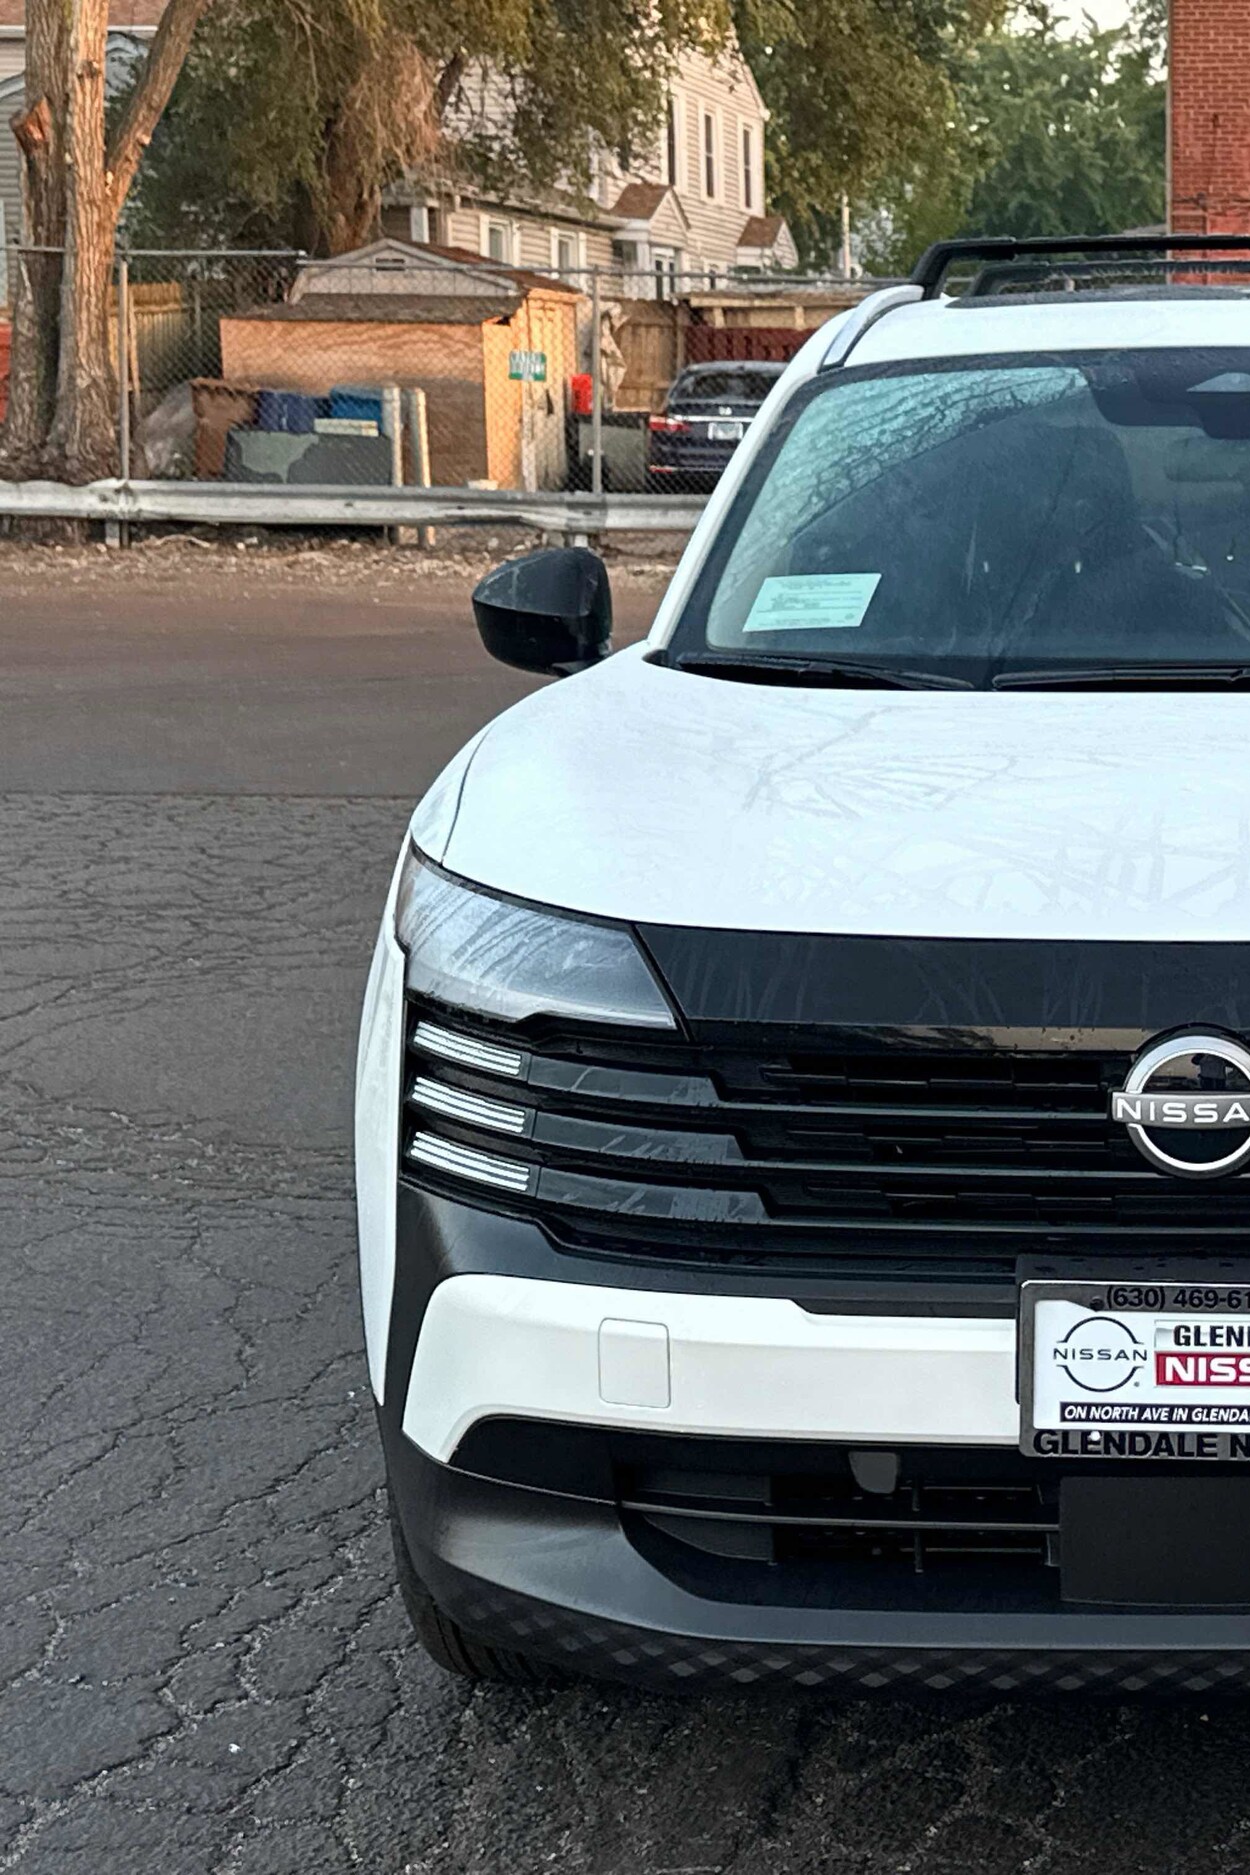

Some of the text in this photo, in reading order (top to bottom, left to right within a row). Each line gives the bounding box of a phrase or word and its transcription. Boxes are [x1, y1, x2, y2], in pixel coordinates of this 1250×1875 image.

[1107, 1285, 1166, 1310] (630)
[1053, 1348, 1148, 1362] NISSAN
[1064, 1405, 1087, 1419] ON
[1089, 1406, 1138, 1421] NORTH
[1142, 1407, 1170, 1421] AVE
[1172, 1408, 1188, 1421] IN
[1033, 1429, 1218, 1458] GLENDALE
